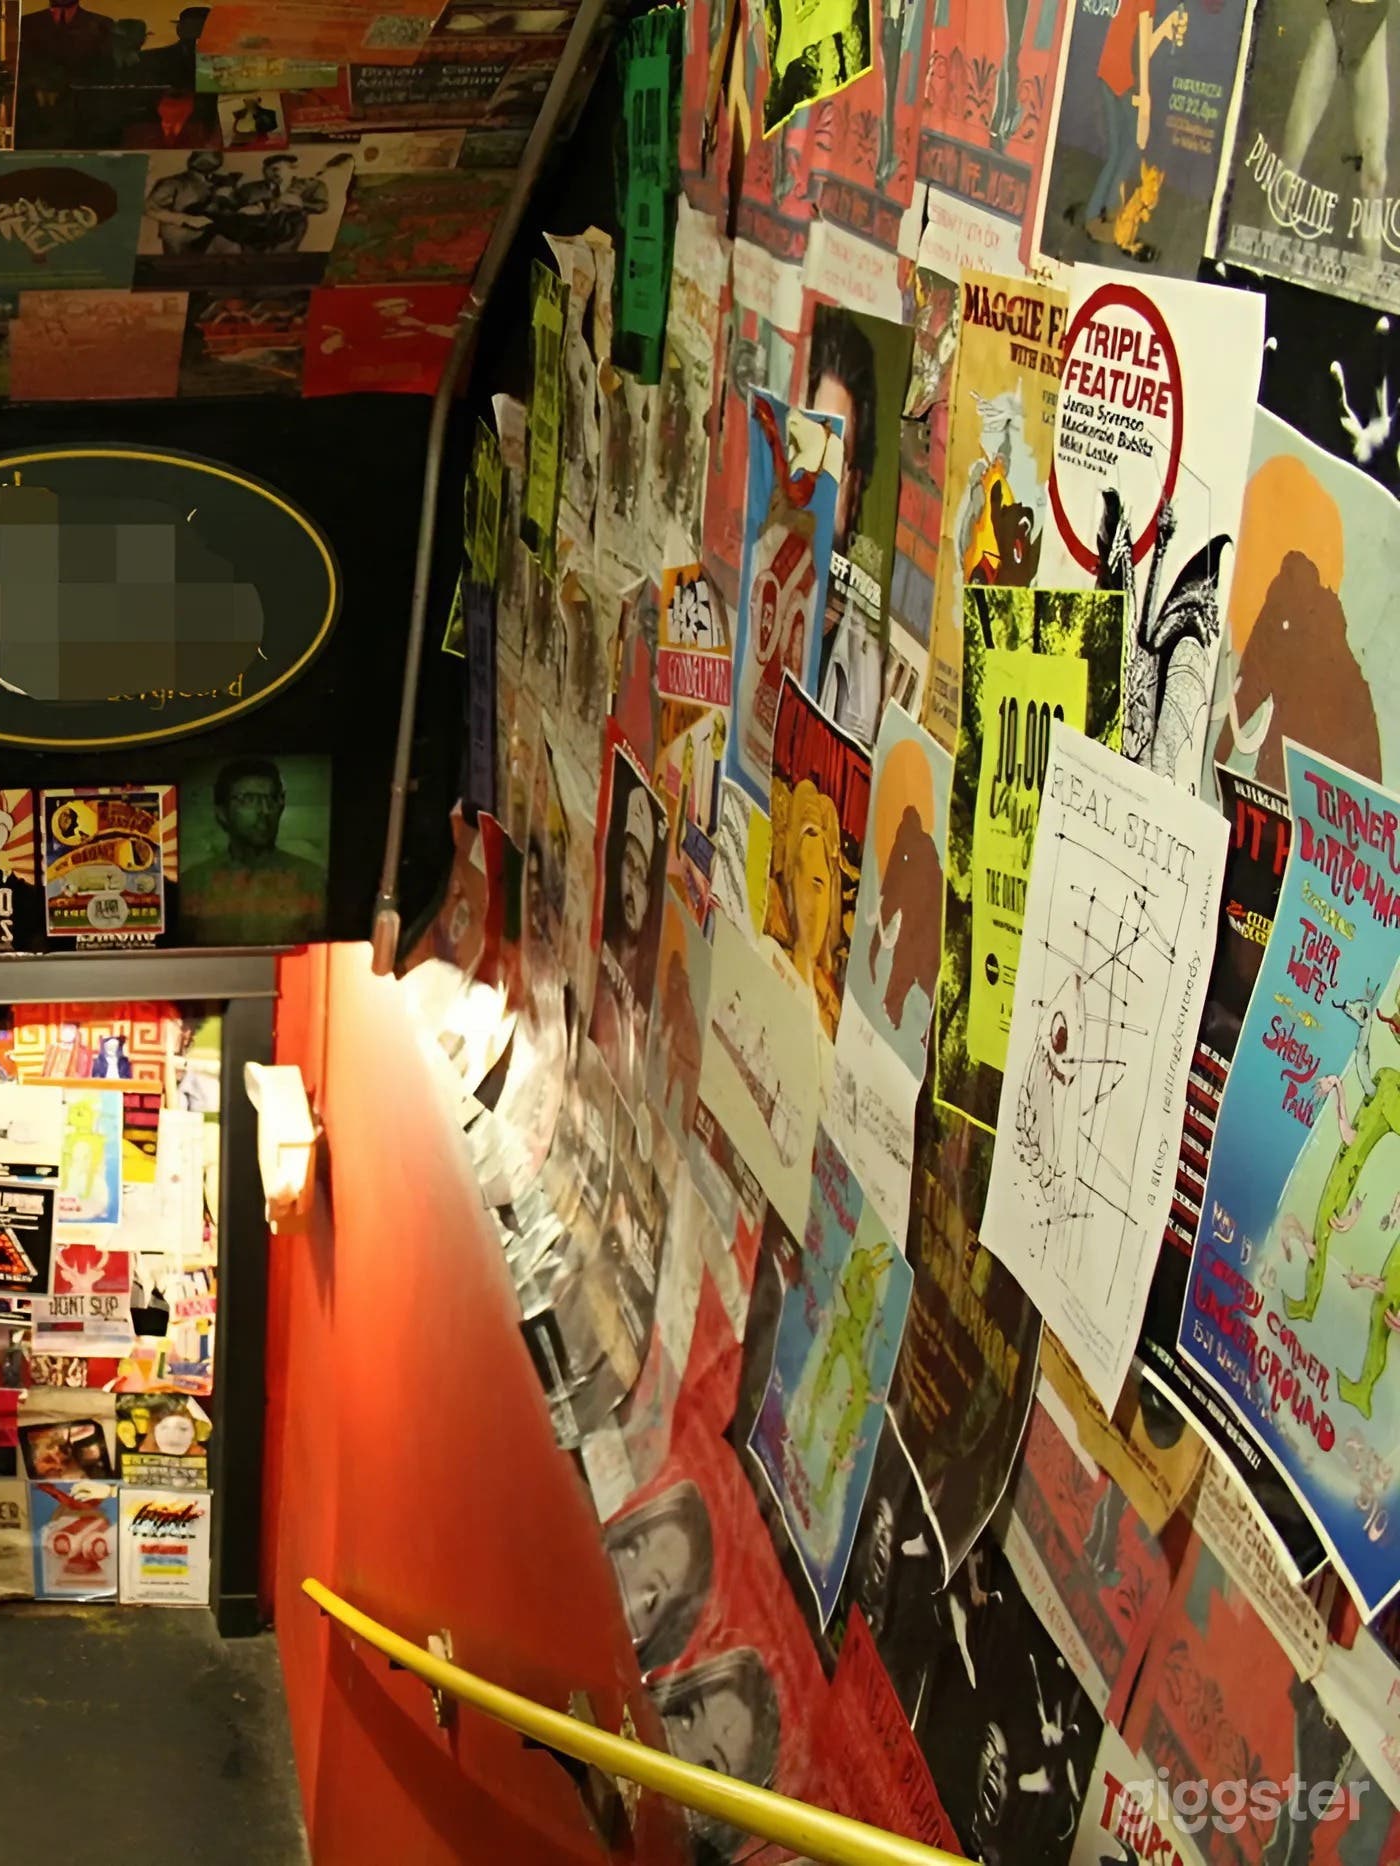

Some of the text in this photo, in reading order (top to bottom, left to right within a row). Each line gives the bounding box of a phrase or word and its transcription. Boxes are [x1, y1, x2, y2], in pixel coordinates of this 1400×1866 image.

[964, 283, 1044, 342] MAGGIE
[1084, 320, 1162, 371] TRIPLE
[1064, 359, 1171, 419] FEATURE
[1050, 762, 1197, 886] REAL SHIT
[1304, 769, 1400, 875] TURNER
[1193, 1272, 1336, 1452] UNDERGROUND
[1265, 1310, 1331, 1402] CORNER
